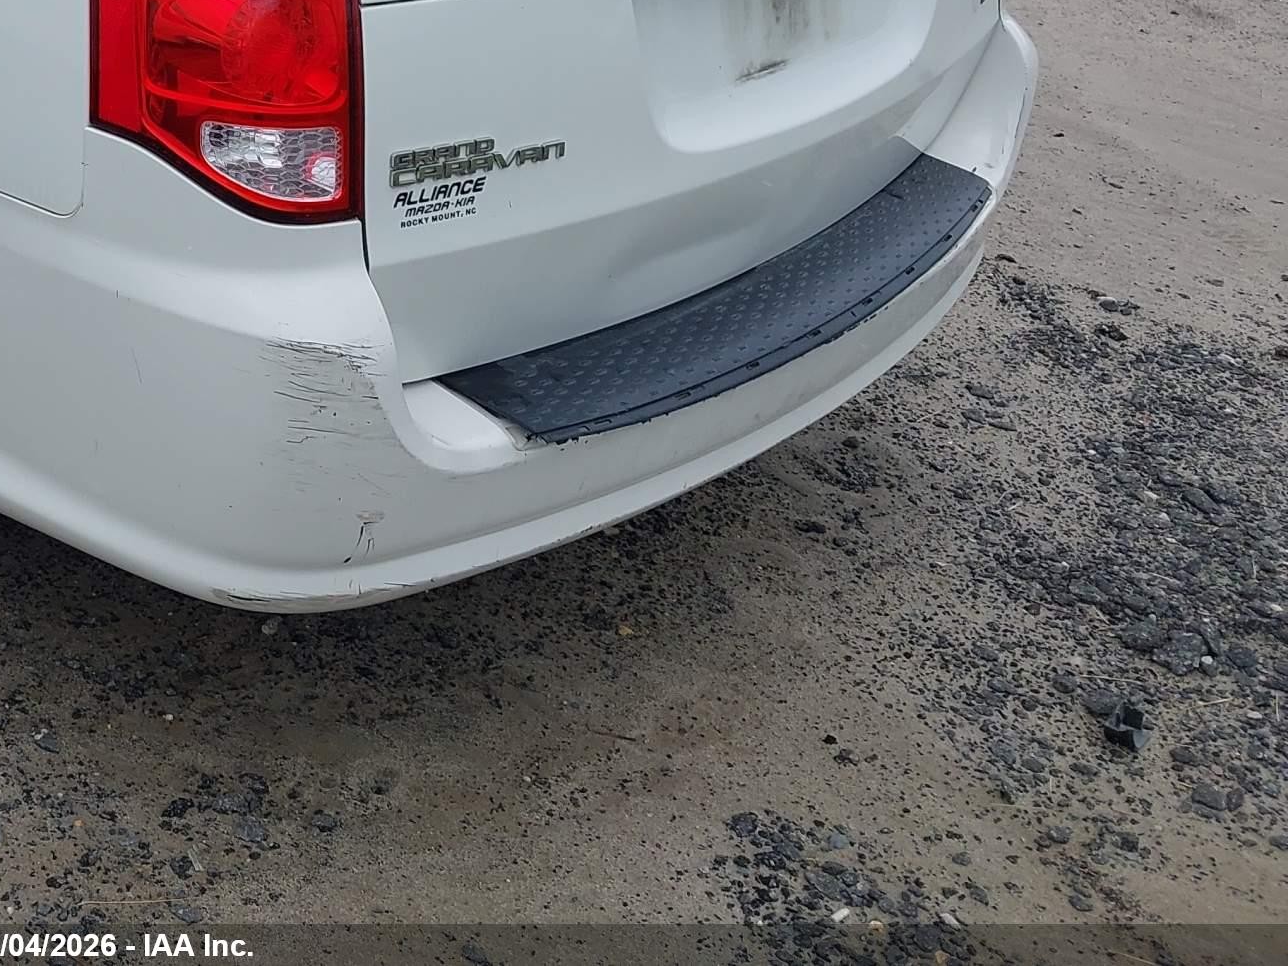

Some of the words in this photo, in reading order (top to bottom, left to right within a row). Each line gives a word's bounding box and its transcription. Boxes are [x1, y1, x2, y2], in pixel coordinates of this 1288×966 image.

[390, 136, 495, 169] GRAND
[390, 139, 566, 187] CARAVAN
[393, 176, 487, 208] ALLIANCE
[400, 217, 430, 228] ROCKY
[431, 210, 464, 223] MOUNT,
[465, 207, 477, 216] NC
